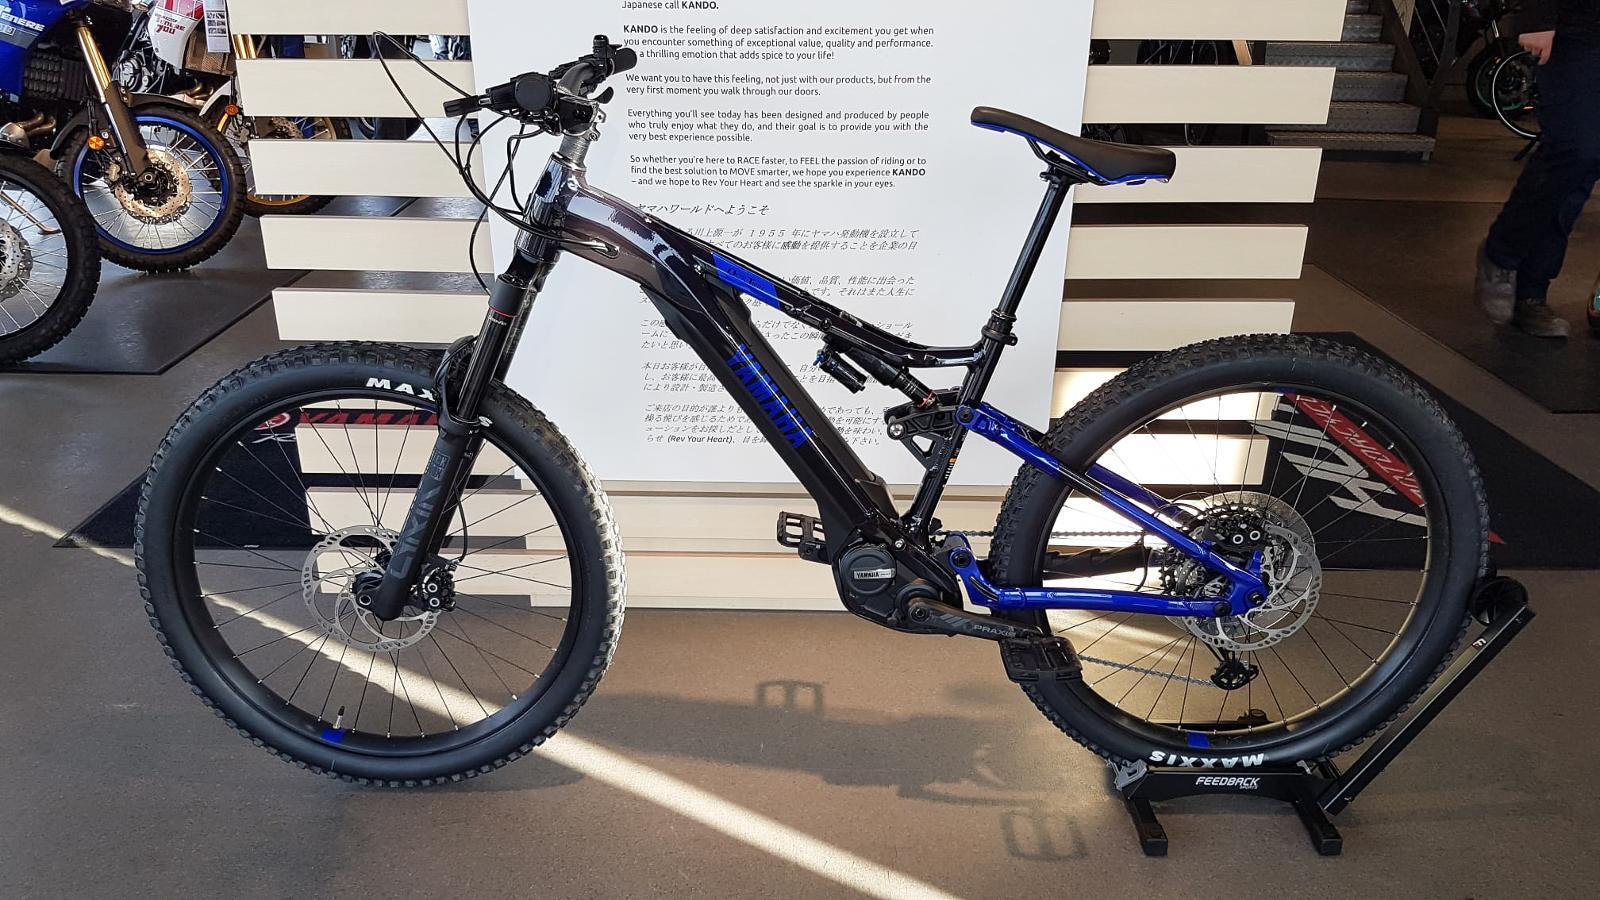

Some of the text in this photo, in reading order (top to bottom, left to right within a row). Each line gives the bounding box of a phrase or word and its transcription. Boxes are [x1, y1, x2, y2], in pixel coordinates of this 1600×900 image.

[622, 0, 719, 11] Japanese call KANDO.
[623, 25, 934, 37] KANDO is the feeling of deep satisfaction and excitement you get when
[624, 37, 933, 49] you encounter something of exceptional value, quality and performance.
[646, 49, 680, 60] thrilling
[681, 50, 718, 58] emotion
[719, 50, 738, 58] that
[739, 50, 760, 59] adds
[761, 50, 783, 61] spice
[785, 51, 795, 59] to
[796, 52, 816, 61] your
[818, 51, 834, 59] life!
[625, 73, 640, 82] We
[641, 74, 663, 82] want
[664, 75, 680, 84] you
[681, 74, 692, 82] to
[692, 74, 712, 82] have
[714, 74, 731, 82] this
[731, 74, 764, 85] feeling,
[765, 75, 780, 83] not
[781, 74, 797, 85] just
[799, 74, 818, 83] with
[836, 75, 876, 85] products,
[878, 75, 892, 83] but
[894, 75, 915, 83] from
[917, 75, 931, 84] the
[626, 87, 645, 96] very
[646, 85, 665, 94] first
[703, 88, 719, 97] you
[720, 86, 740, 95] walk
[742, 86, 776, 97] through
[794, 87, 821, 95] doors.
[628, 109, 672, 120] Everything
[674, 109, 698, 120] you'll
[717, 109, 742, 120] today
[744, 110, 759, 118] has
[761, 110, 782, 118] been
[785, 110, 823, 120] designed
[825, 110, 842, 118] and
[844, 110, 884, 121] produced
[887, 110, 898, 121] by
[900, 110, 929, 121] people
[628, 120, 646, 129] who
[649, 121, 669, 131] truly
[671, 121, 694, 131] enjoy
[696, 121, 717, 129] what
[720, 121, 739, 132] they
[741, 121, 755, 131] do,
[757, 121, 773, 130] and
[775, 121, 795, 130] their
[798, 122, 816, 132] goal
[819, 122, 826, 130] is
[840, 122, 872, 132] provide
[874, 124, 890, 133] you
[893, 122, 911, 130] with
[914, 122, 929, 130] the
[628, 132, 753, 143] very best experience possible.
[630, 154, 641, 162] So
[642, 154, 677, 163] whether
[678, 155, 704, 165] you're
[706, 155, 725, 163] here
[737, 155, 760, 163] RACE
[761, 155, 788, 165] faster,
[800, 156, 820, 164] FEEL
[821, 156, 836, 164] the
[837, 156, 869, 166] passion
[870, 156, 880, 164] of
[881, 156, 905, 167] riding
[631, 166, 647, 174] find
[649, 166, 663, 174] the
[664, 166, 683, 174] best
[684, 166, 718, 175] solution
[729, 167, 755, 175] MOVE
[757, 168, 791, 176] smarter,
[805, 167, 827, 178] hope
[828, 169, 844, 178] you
[845, 168, 890, 178] experience
[892, 168, 926, 176] KANDO
[638, 178, 653, 186] and
[669, 178, 690, 188] hope
[702, 178, 718, 186] Rev
[719, 178, 738, 186] Your
[740, 178, 763, 186] Heart
[765, 178, 780, 186] and
[797, 179, 812, 187] the
[813, 179, 843, 189] sparkle
[845, 179, 853, 187] in
[854, 181, 873, 190] your
[874, 181, 895, 190] eyes.
[726, 342, 813, 448] YAMAHA
[668, 434, 685, 443] (Rev
[1149, 750, 1264, 768] MAXXIS
[1195, 776, 1260, 786] FEEDBACK
